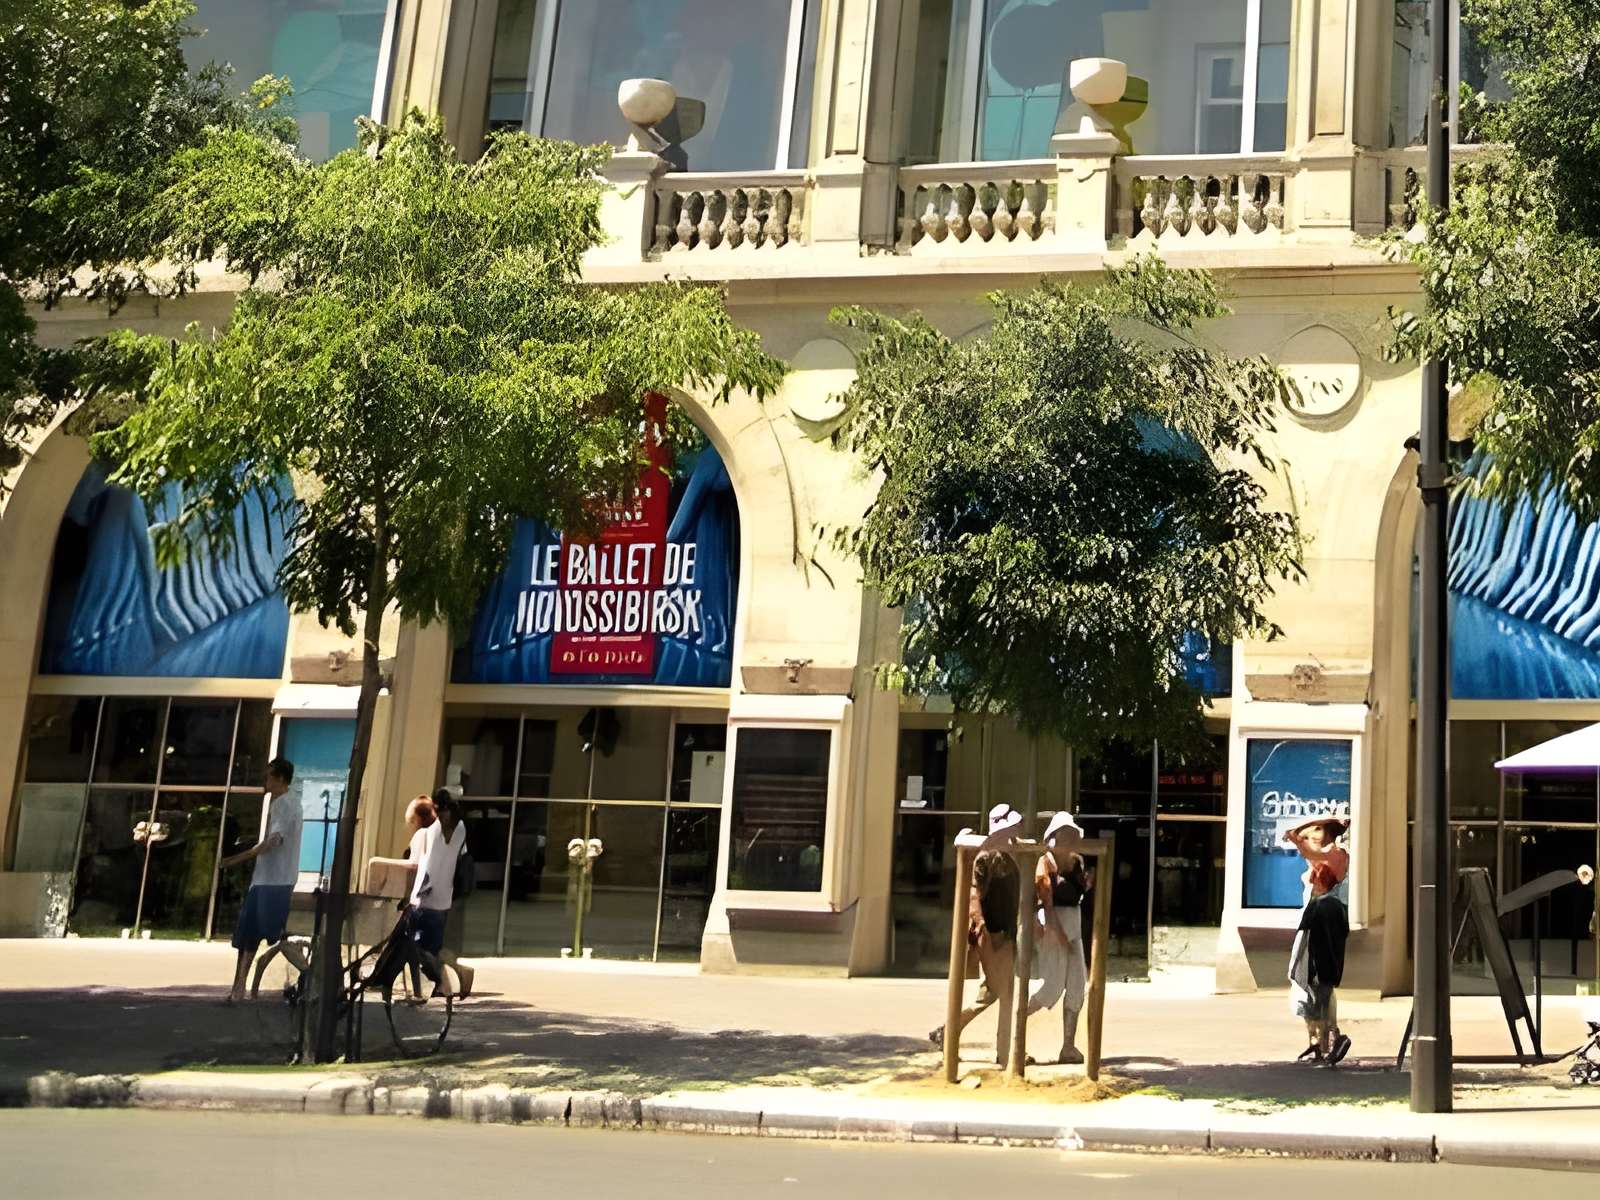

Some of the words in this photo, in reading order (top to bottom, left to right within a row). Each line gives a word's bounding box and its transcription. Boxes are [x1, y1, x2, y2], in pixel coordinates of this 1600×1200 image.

[530, 544, 560, 586] LE
[566, 543, 656, 585] BALLET
[662, 542, 697, 585] DE
